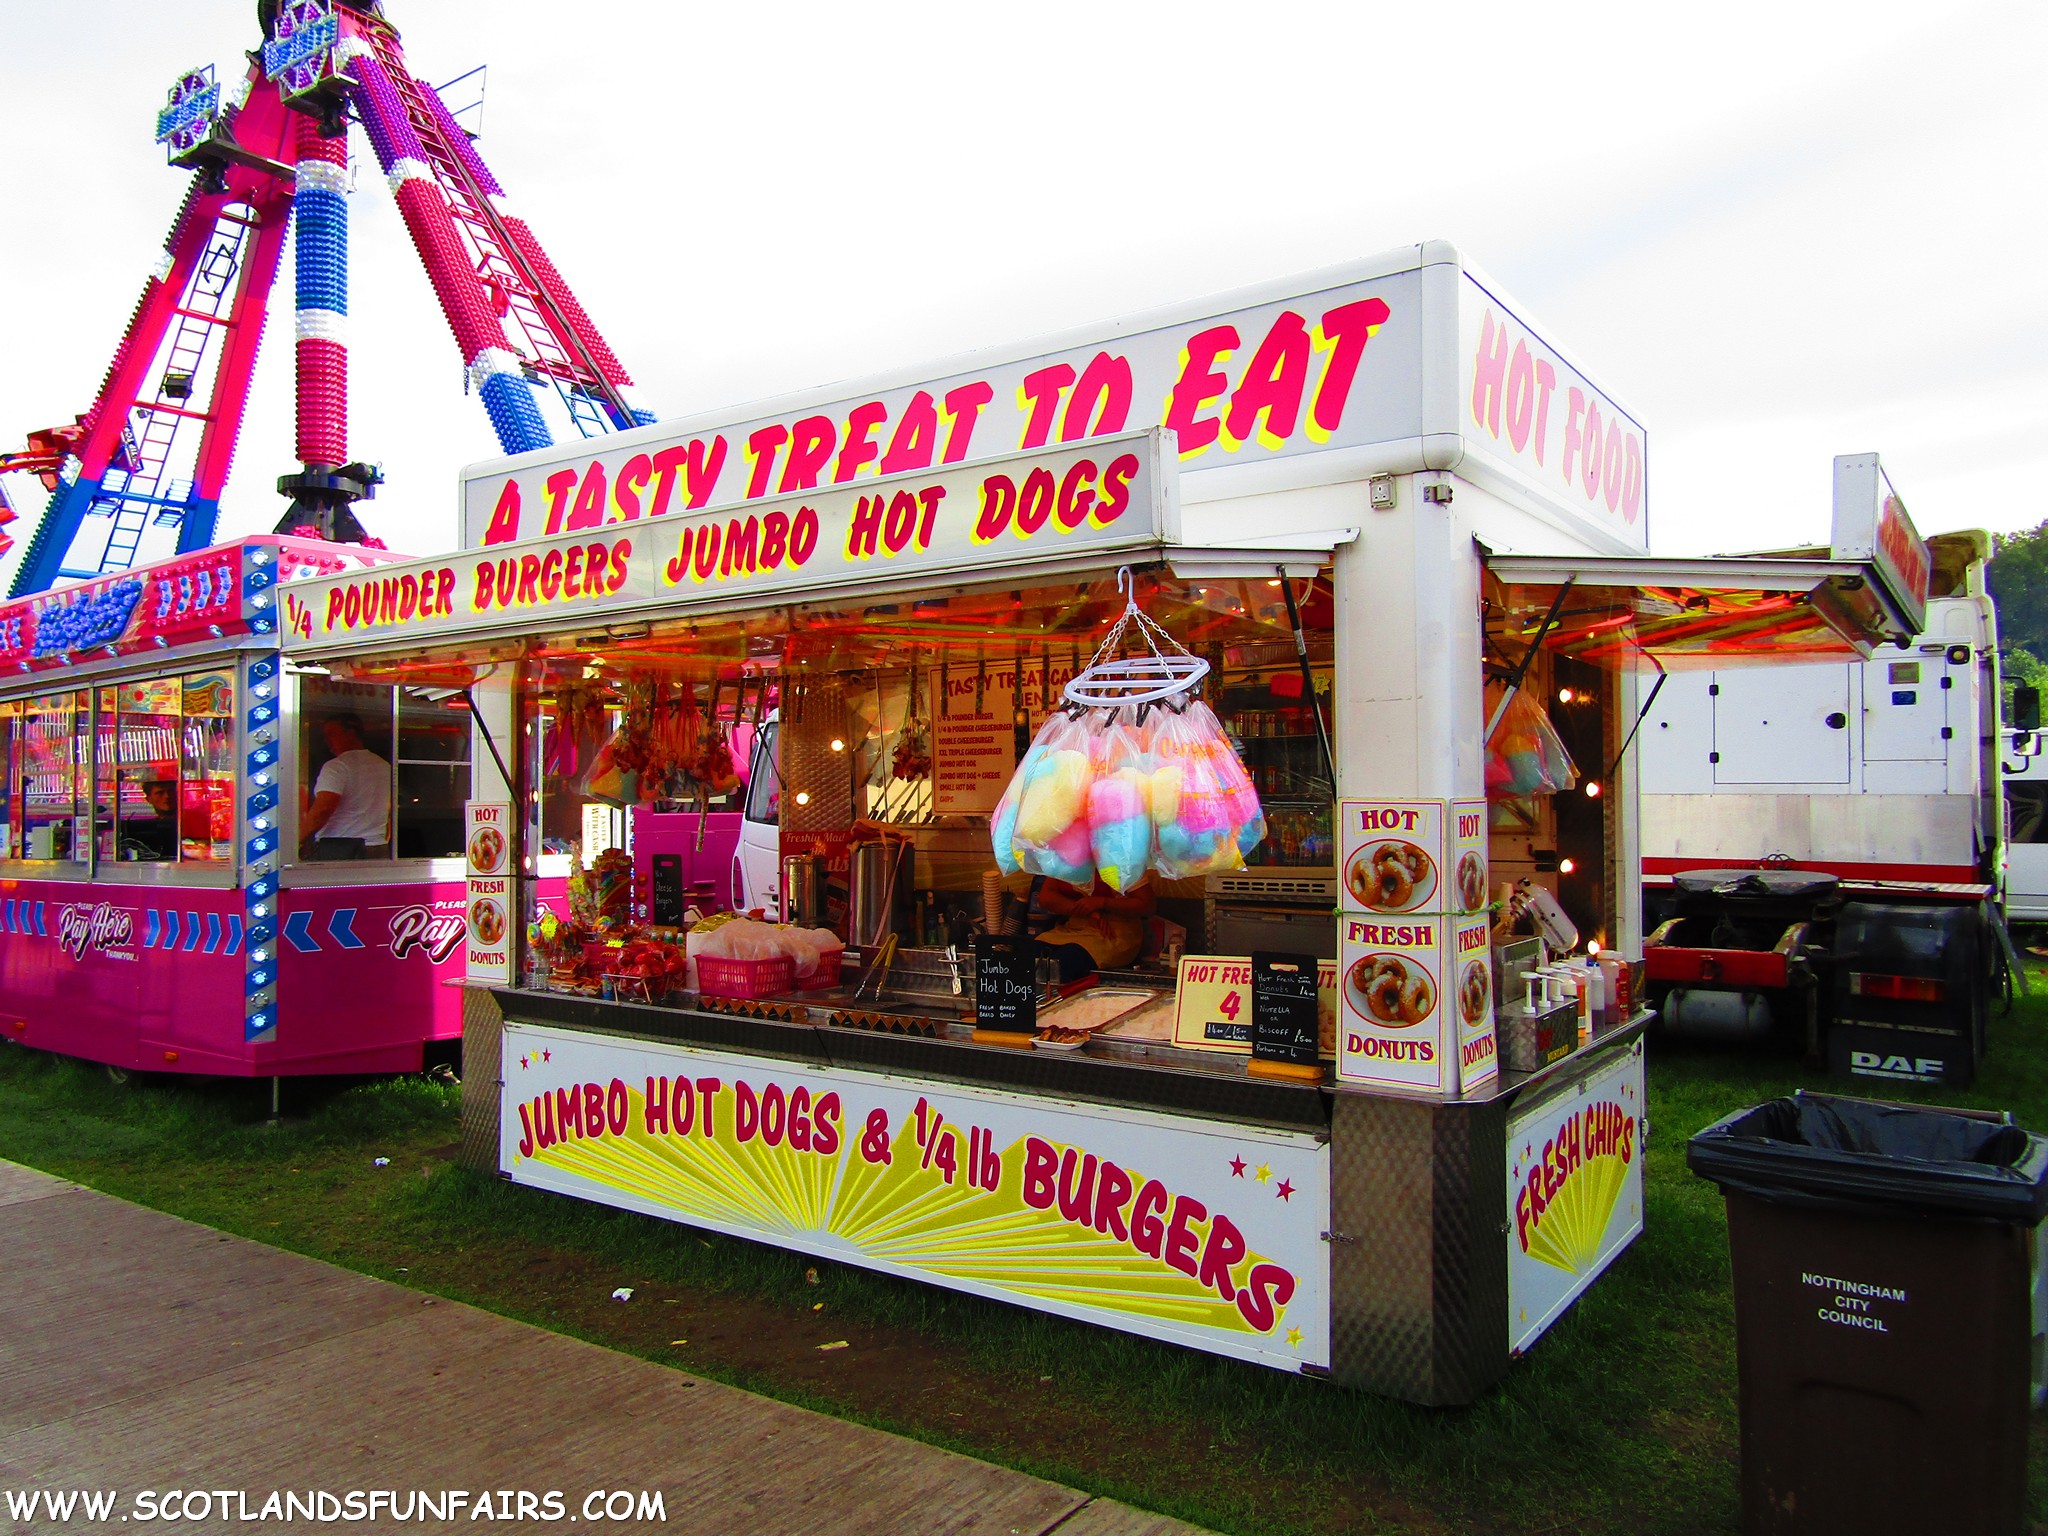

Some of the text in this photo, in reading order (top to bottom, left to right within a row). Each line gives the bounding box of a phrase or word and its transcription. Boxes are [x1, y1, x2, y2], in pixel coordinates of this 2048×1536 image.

[481, 297, 1390, 545] A TASTY TREAT TO EAT
[1471, 307, 1642, 525] HOT FOOD
[287, 453, 1140, 639] 1/4 POUNDER BURGERS JUMBO HOT DOGS
[952, 725, 974, 733] POUNDER
[975, 723, 1012, 732] CHEESEBURGER
[939, 736, 994, 745] DOUBLE CHEESEBURGER
[948, 748, 965, 756] TRIPLE
[965, 747, 1002, 756] CHEESEBURGER
[939, 772, 956, 780] JUMBO
[982, 771, 1000, 780] CHEESE
[940, 783, 976, 791] SMALL HOT DOG
[475, 809, 499, 822] HOT
[1361, 808, 1419, 831] HOT
[1459, 813, 1480, 838] HOT
[785, 832, 821, 843] Freshly
[470, 880, 504, 893] FRESH
[60, 902, 132, 959] Pay Here
[390, 905, 466, 962] Pay
[1348, 921, 1432, 946] FRESH
[1458, 926, 1486, 953] FRESH
[470, 952, 505, 965] DONUTS
[981, 959, 1010, 974] Jumbo
[1187, 965, 1218, 983] HOT
[1222, 967, 1252, 985] FRE
[980, 978, 1033, 1001] Hot Dogs
[1219, 990, 1241, 1021] 4
[1290, 1047, 1297, 1058] 4
[1347, 1033, 1434, 1062] DONUTS
[1462, 1033, 1493, 1069] DONUTS
[1851, 1051, 1943, 1073] DAF
[1515, 1101, 1634, 1253] FRESH CHIPS
[519, 1075, 1296, 1332] JUMBO HOT DOGS & 1/4 lb BURGERS
[1802, 1272, 1906, 1302] NOTTINGHAM
[1835, 1295, 1871, 1312] CITY
[1817, 1308, 1888, 1332] COUNCIL
